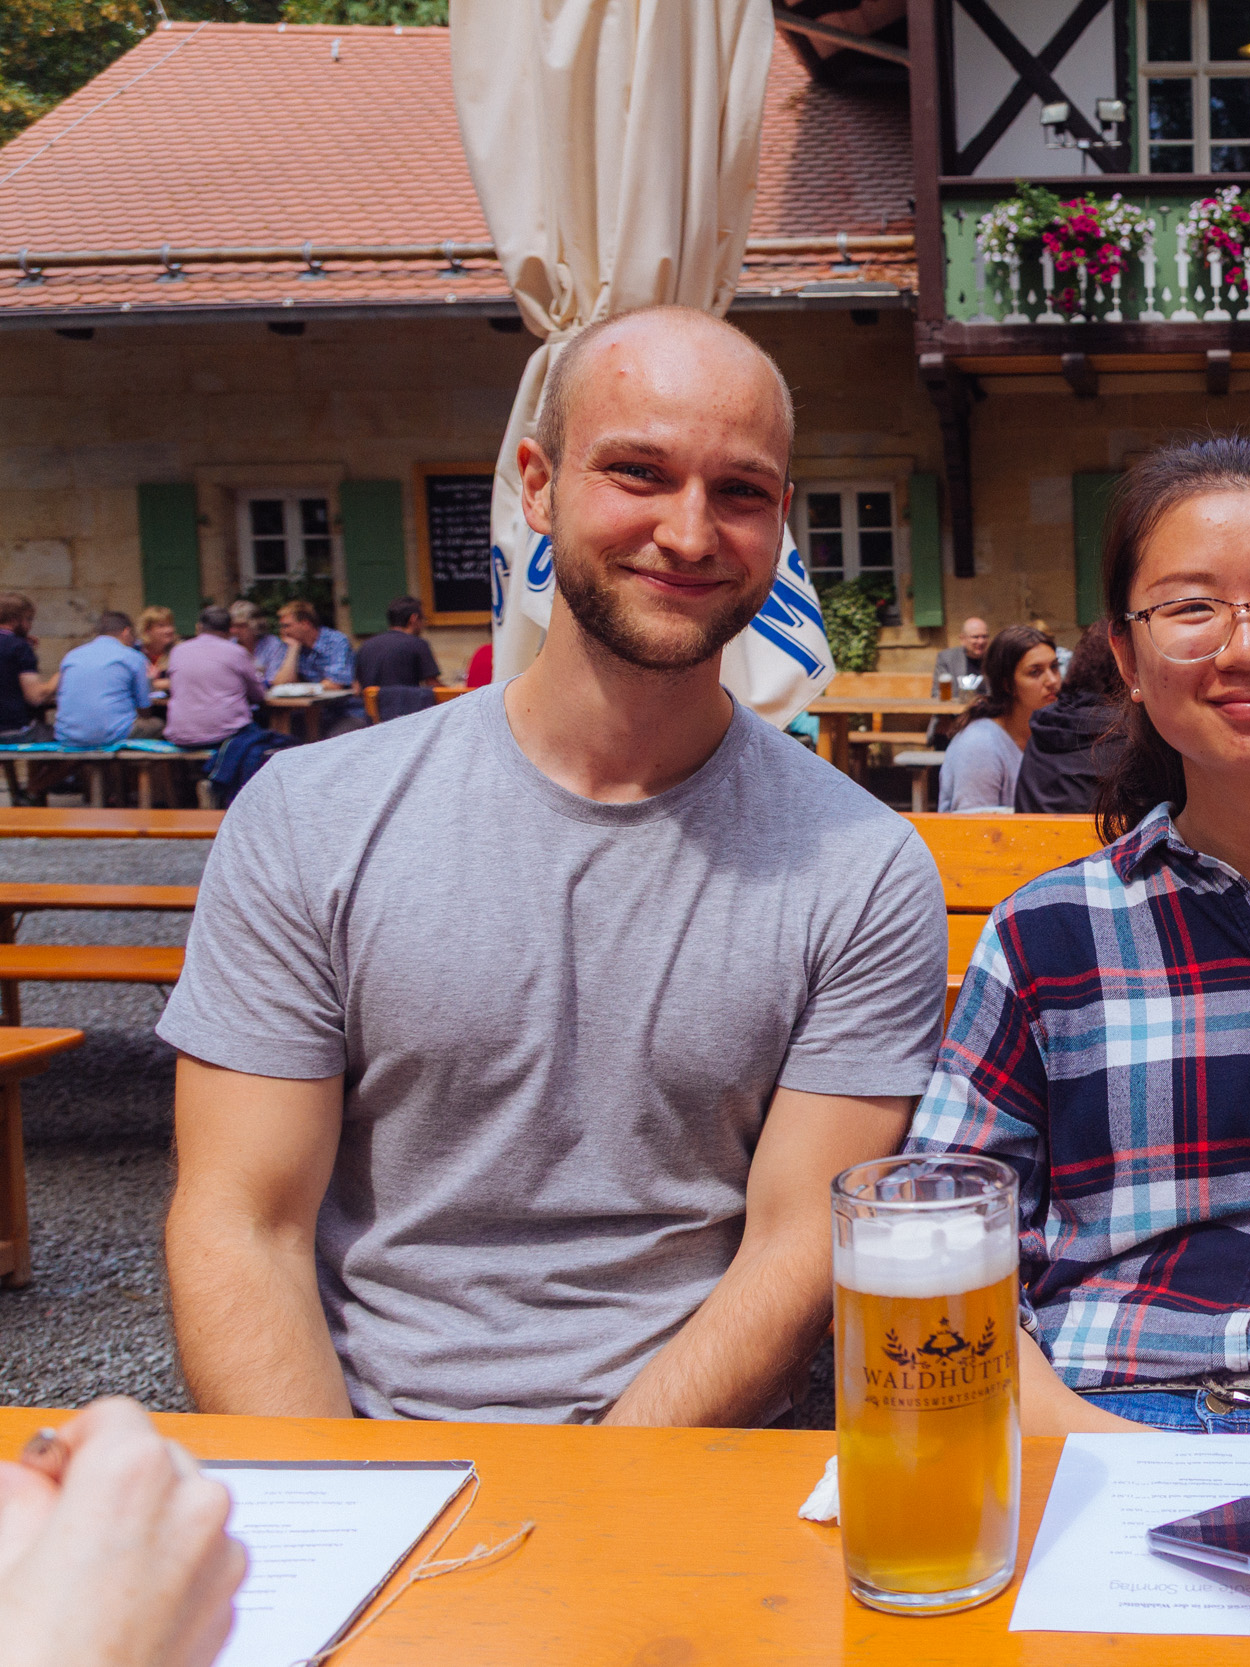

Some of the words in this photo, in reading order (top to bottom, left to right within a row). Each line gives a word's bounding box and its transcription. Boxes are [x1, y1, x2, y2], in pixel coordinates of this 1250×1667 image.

[863, 1349, 1014, 1390] WALDHÜTTE
[1108, 1579, 1178, 1596] Sonntag
[1184, 1582, 1213, 1593] am
